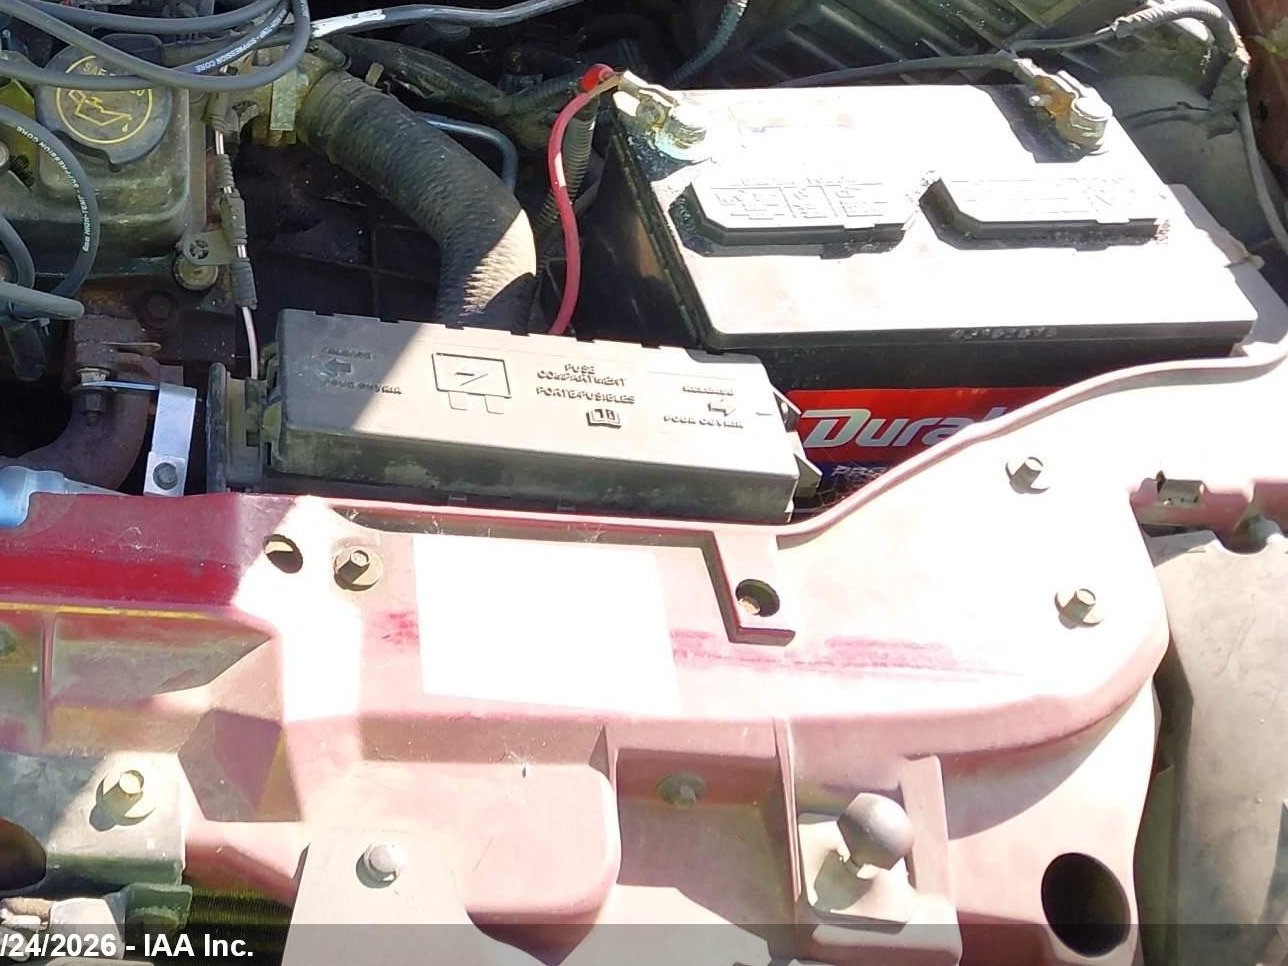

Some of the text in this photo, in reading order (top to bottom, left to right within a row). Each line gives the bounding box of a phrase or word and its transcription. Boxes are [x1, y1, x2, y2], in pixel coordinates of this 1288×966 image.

[215, 37, 257, 65] SUPPRESSION
[194, 61, 216, 73] CORE
[16, 125, 39, 143] CORE
[39, 141, 79, 188] SUPPRESSION
